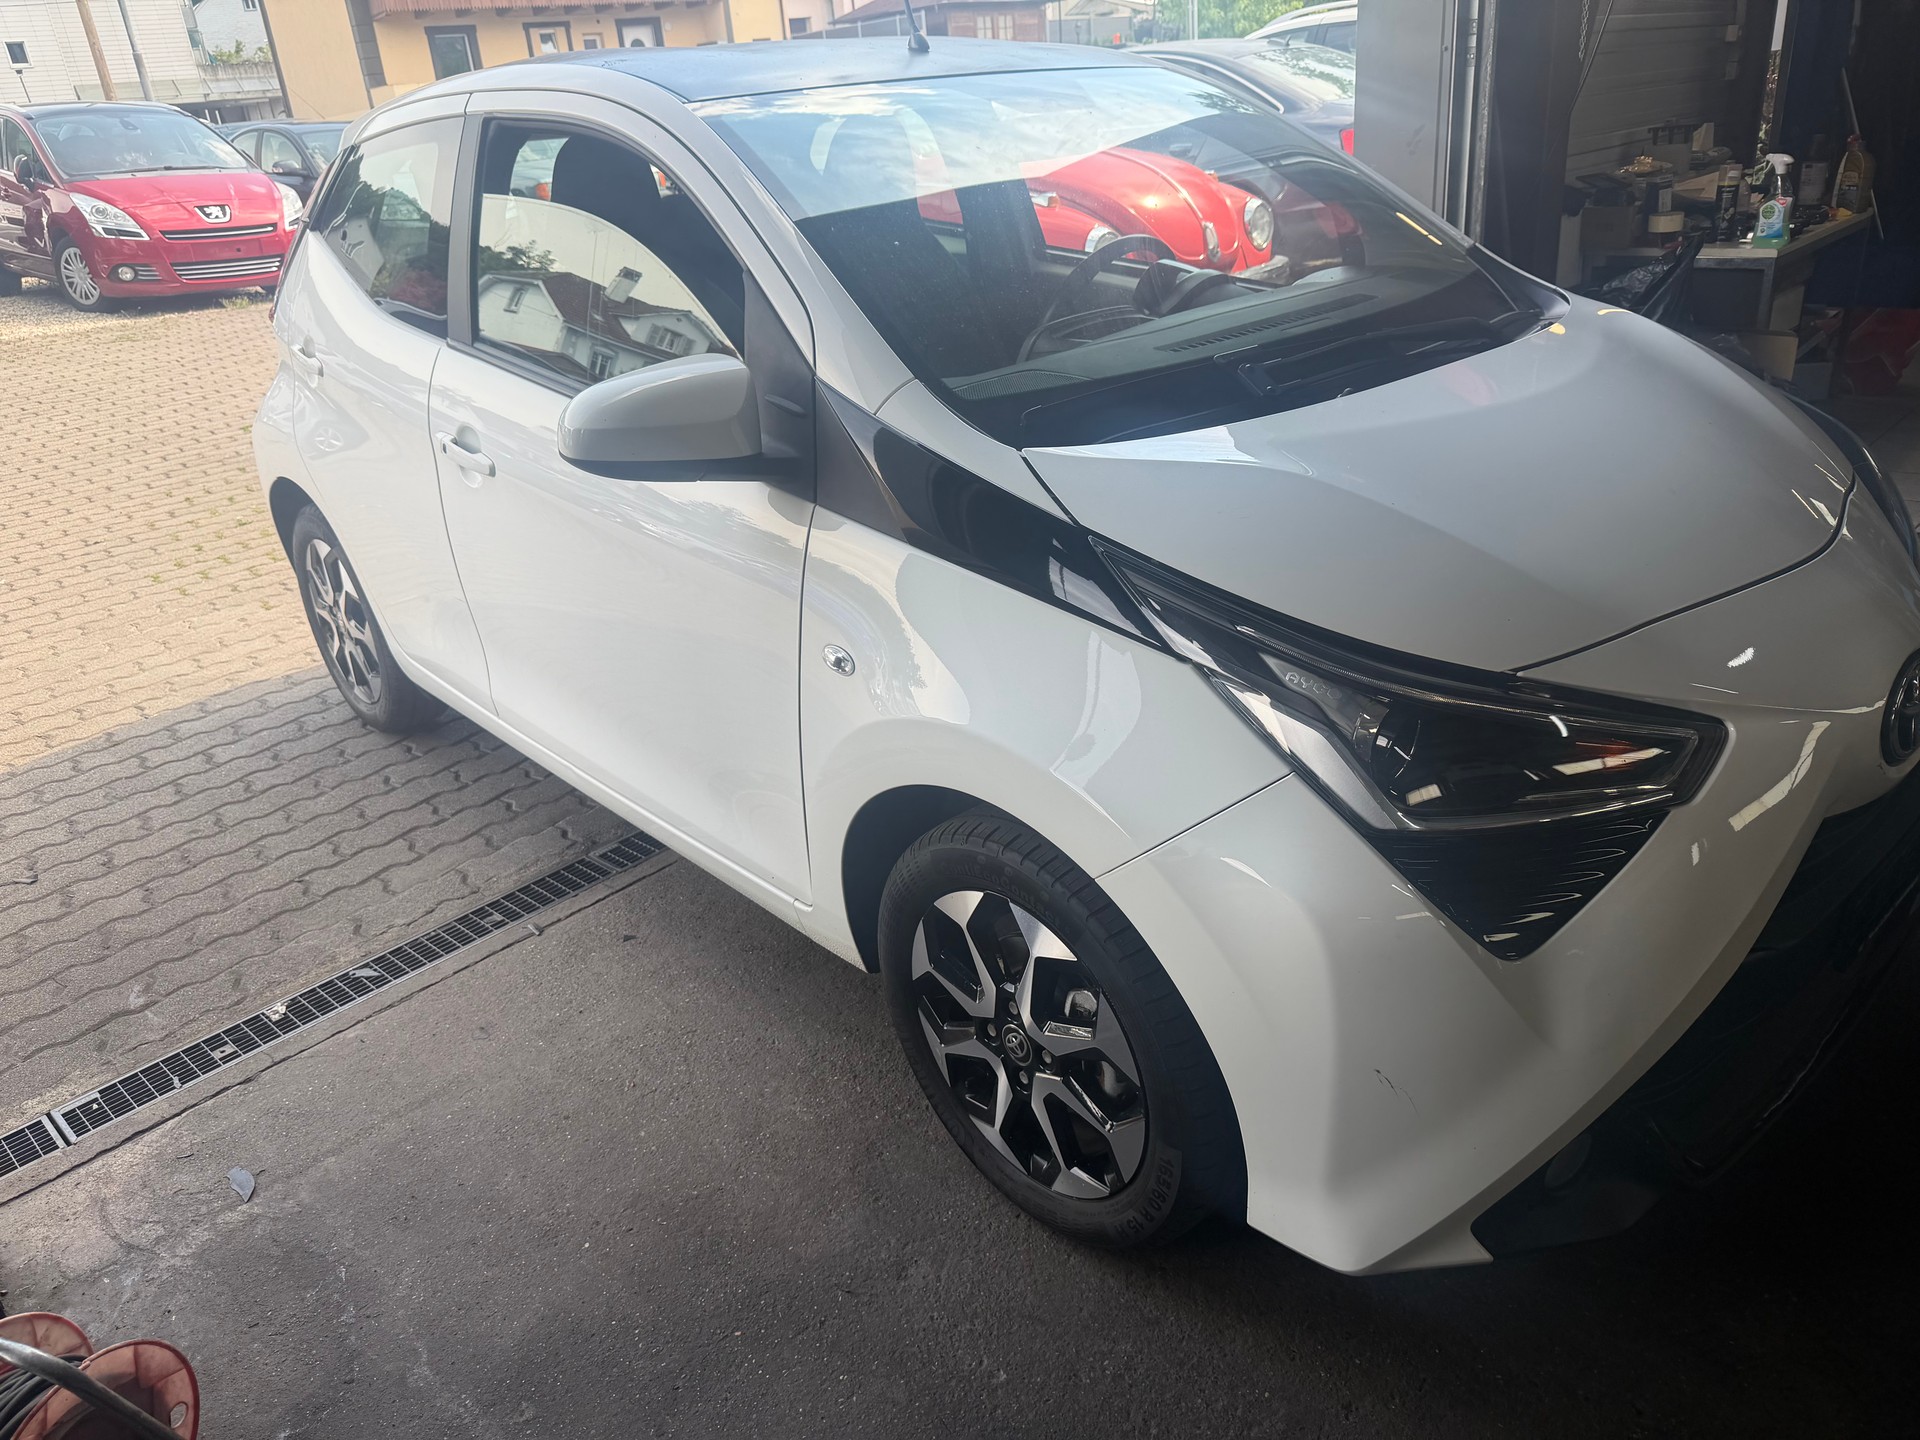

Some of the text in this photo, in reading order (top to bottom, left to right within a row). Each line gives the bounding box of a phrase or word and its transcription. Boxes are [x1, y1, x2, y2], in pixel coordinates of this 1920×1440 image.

[1285, 672, 1342, 699] AYGO
[1149, 1157, 1173, 1211] 165/60
[1127, 1215, 1145, 1234] 15
